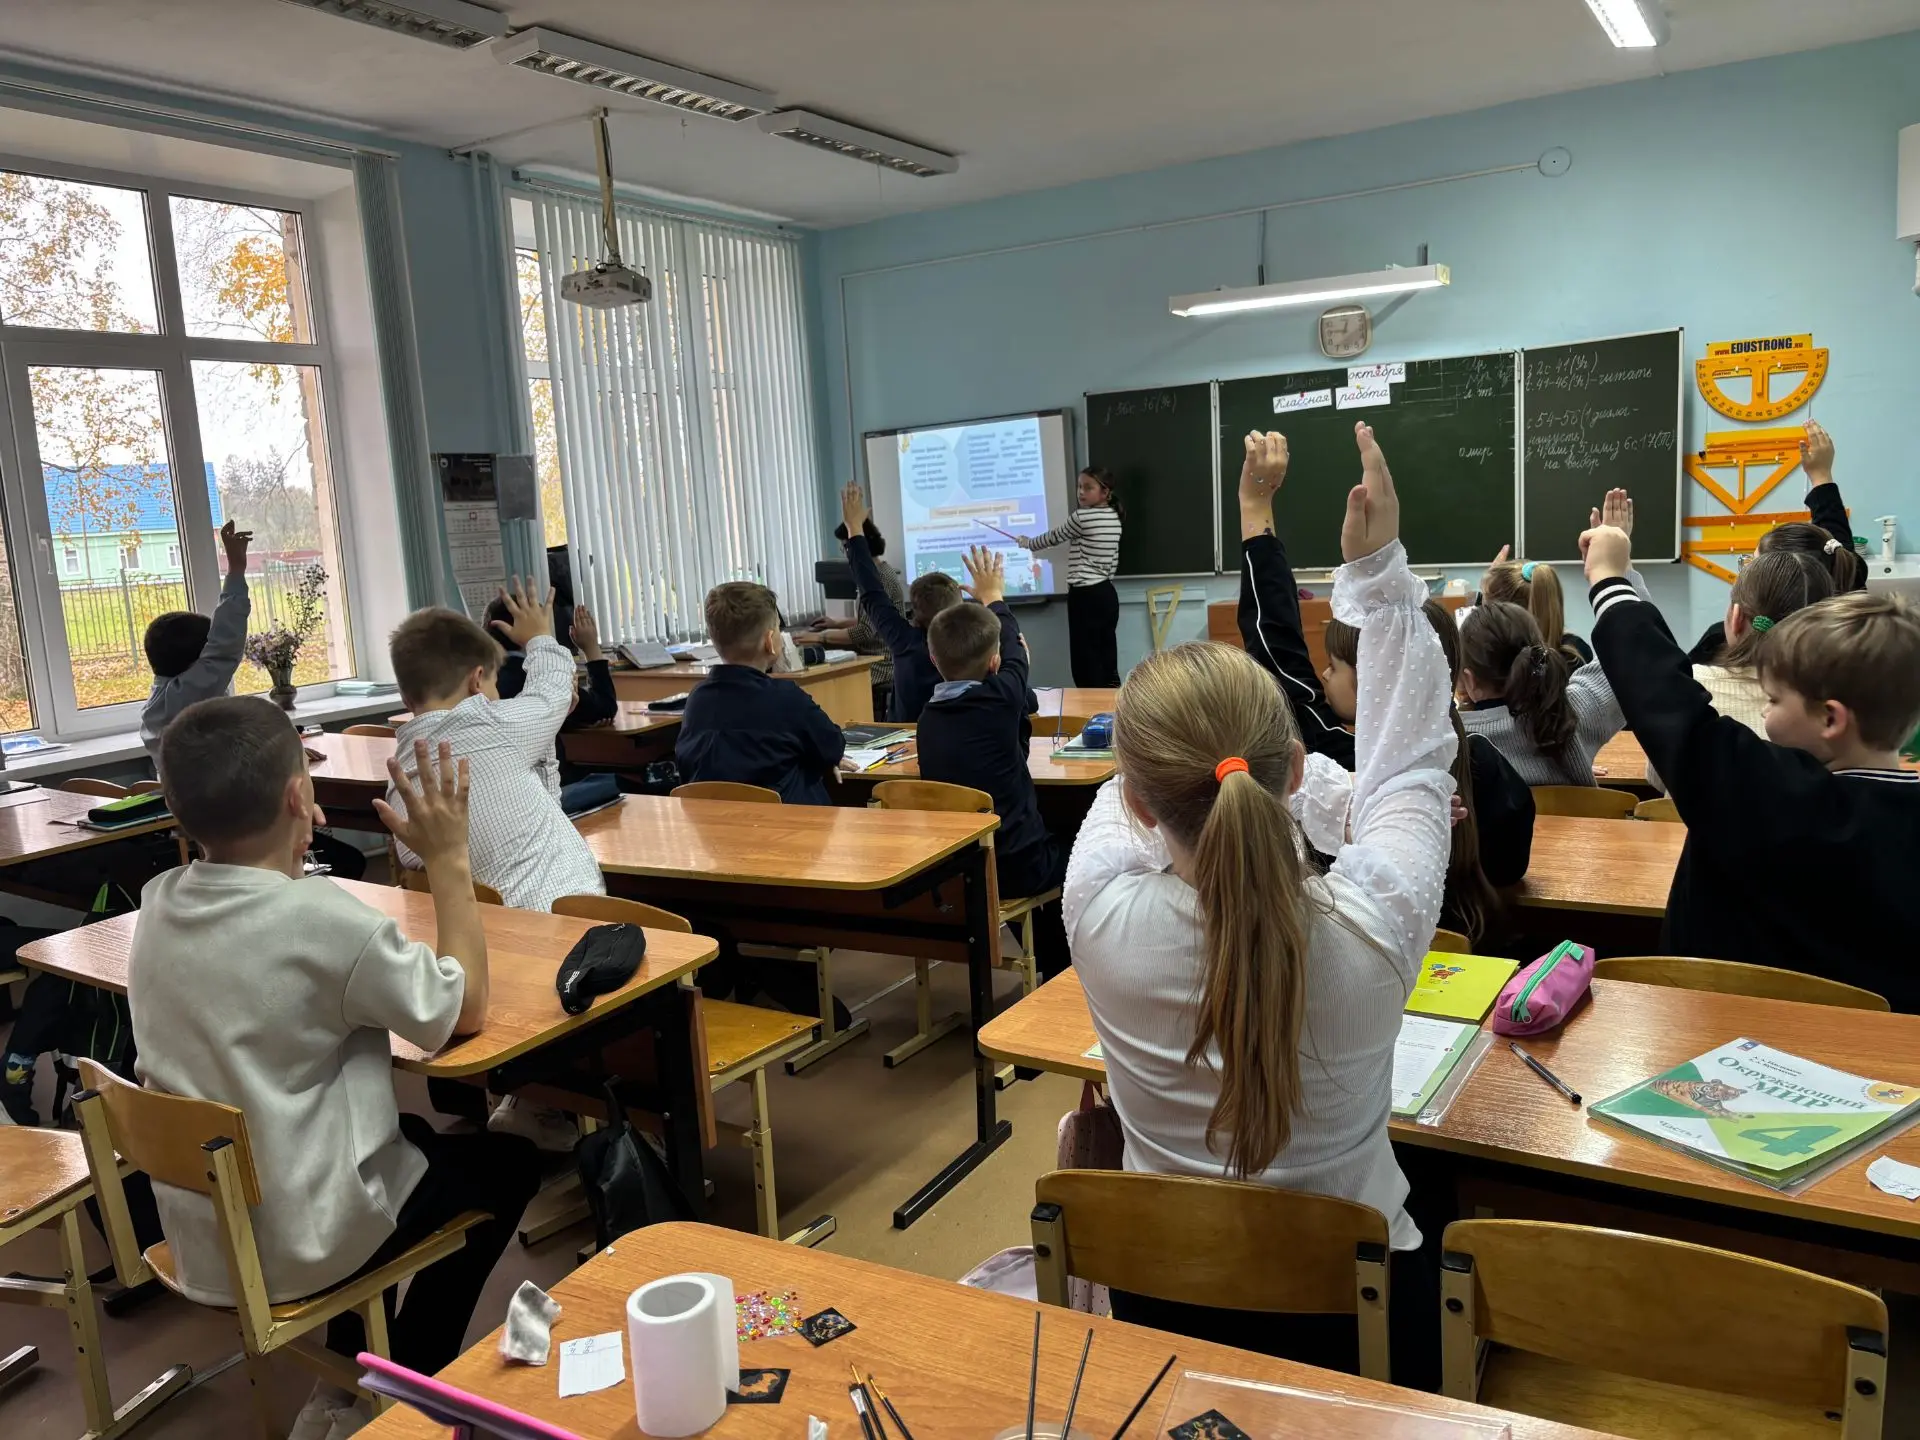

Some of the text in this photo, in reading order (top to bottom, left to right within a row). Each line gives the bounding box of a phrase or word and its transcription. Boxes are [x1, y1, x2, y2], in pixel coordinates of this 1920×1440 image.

[1731, 337, 1792, 354] EDUSTRONG
[1274, 394, 1330, 409] Классная
[1718, 1056, 1867, 1110] Окружающий
[1746, 1080, 1830, 1109] МИР
[1737, 1125, 1842, 1157] 4
